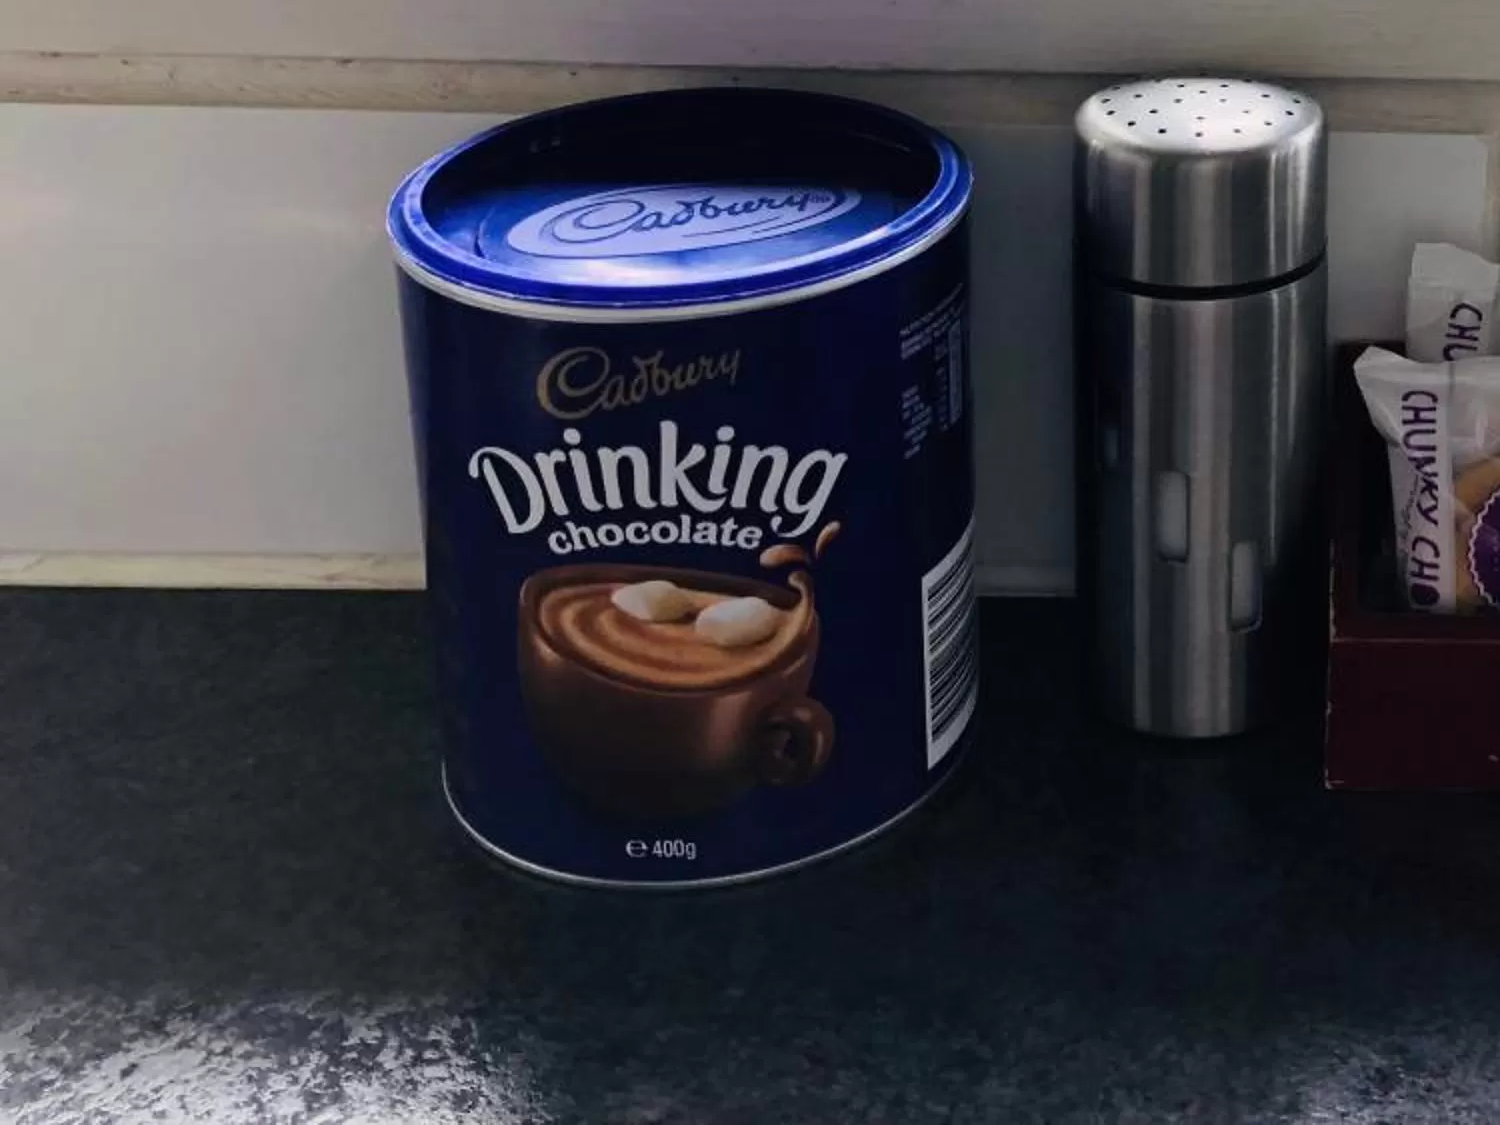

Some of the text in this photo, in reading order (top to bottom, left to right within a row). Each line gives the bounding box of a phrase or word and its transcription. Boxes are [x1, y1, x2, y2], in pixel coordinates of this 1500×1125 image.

[541, 192, 811, 245] Cadbury
[1442, 302, 1484, 362] CHU
[535, 345, 743, 420] Cadbury
[468, 419, 849, 538] Drinking
[1401, 390, 1441, 611] CHUNKY CHO
[547, 514, 764, 556] chocolate
[651, 838, 697, 861] 400g
